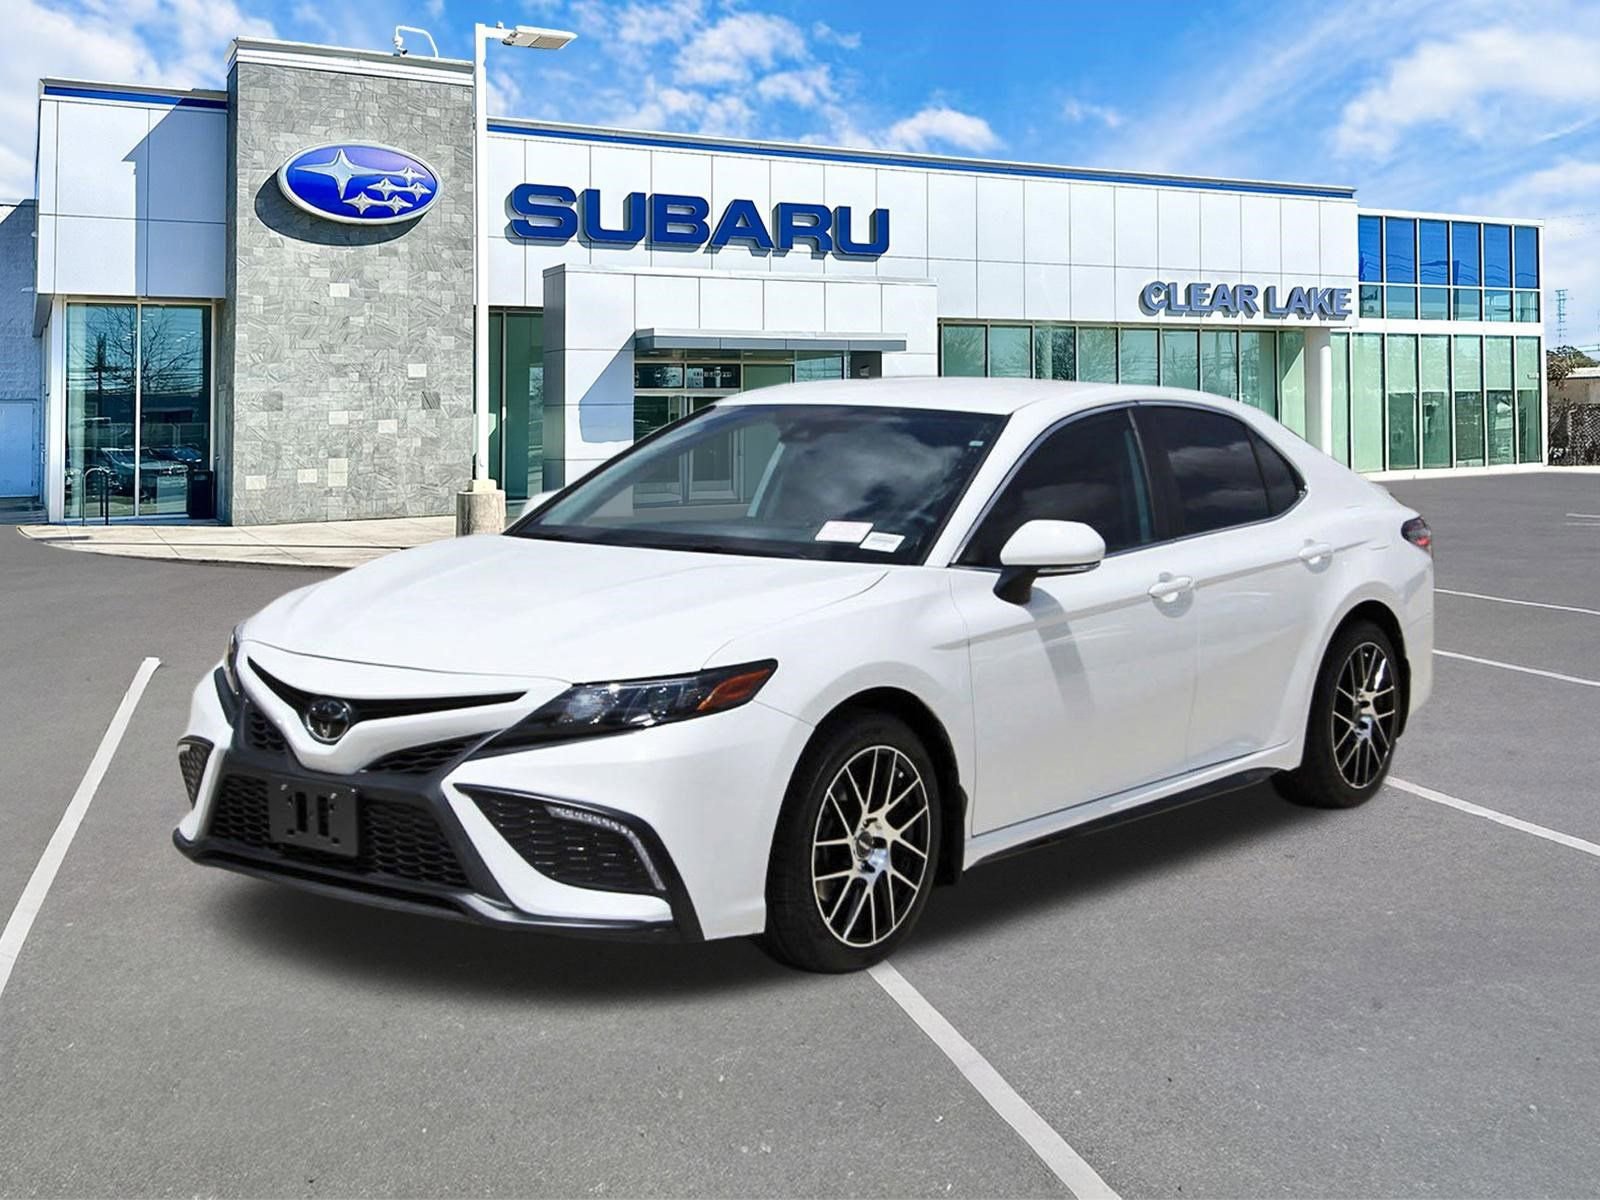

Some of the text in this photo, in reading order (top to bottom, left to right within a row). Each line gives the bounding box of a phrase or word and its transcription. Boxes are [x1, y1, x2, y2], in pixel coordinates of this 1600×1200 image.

[506, 183, 889, 258] SUBARU
[1140, 280, 1352, 320] CLEAR LAKE
